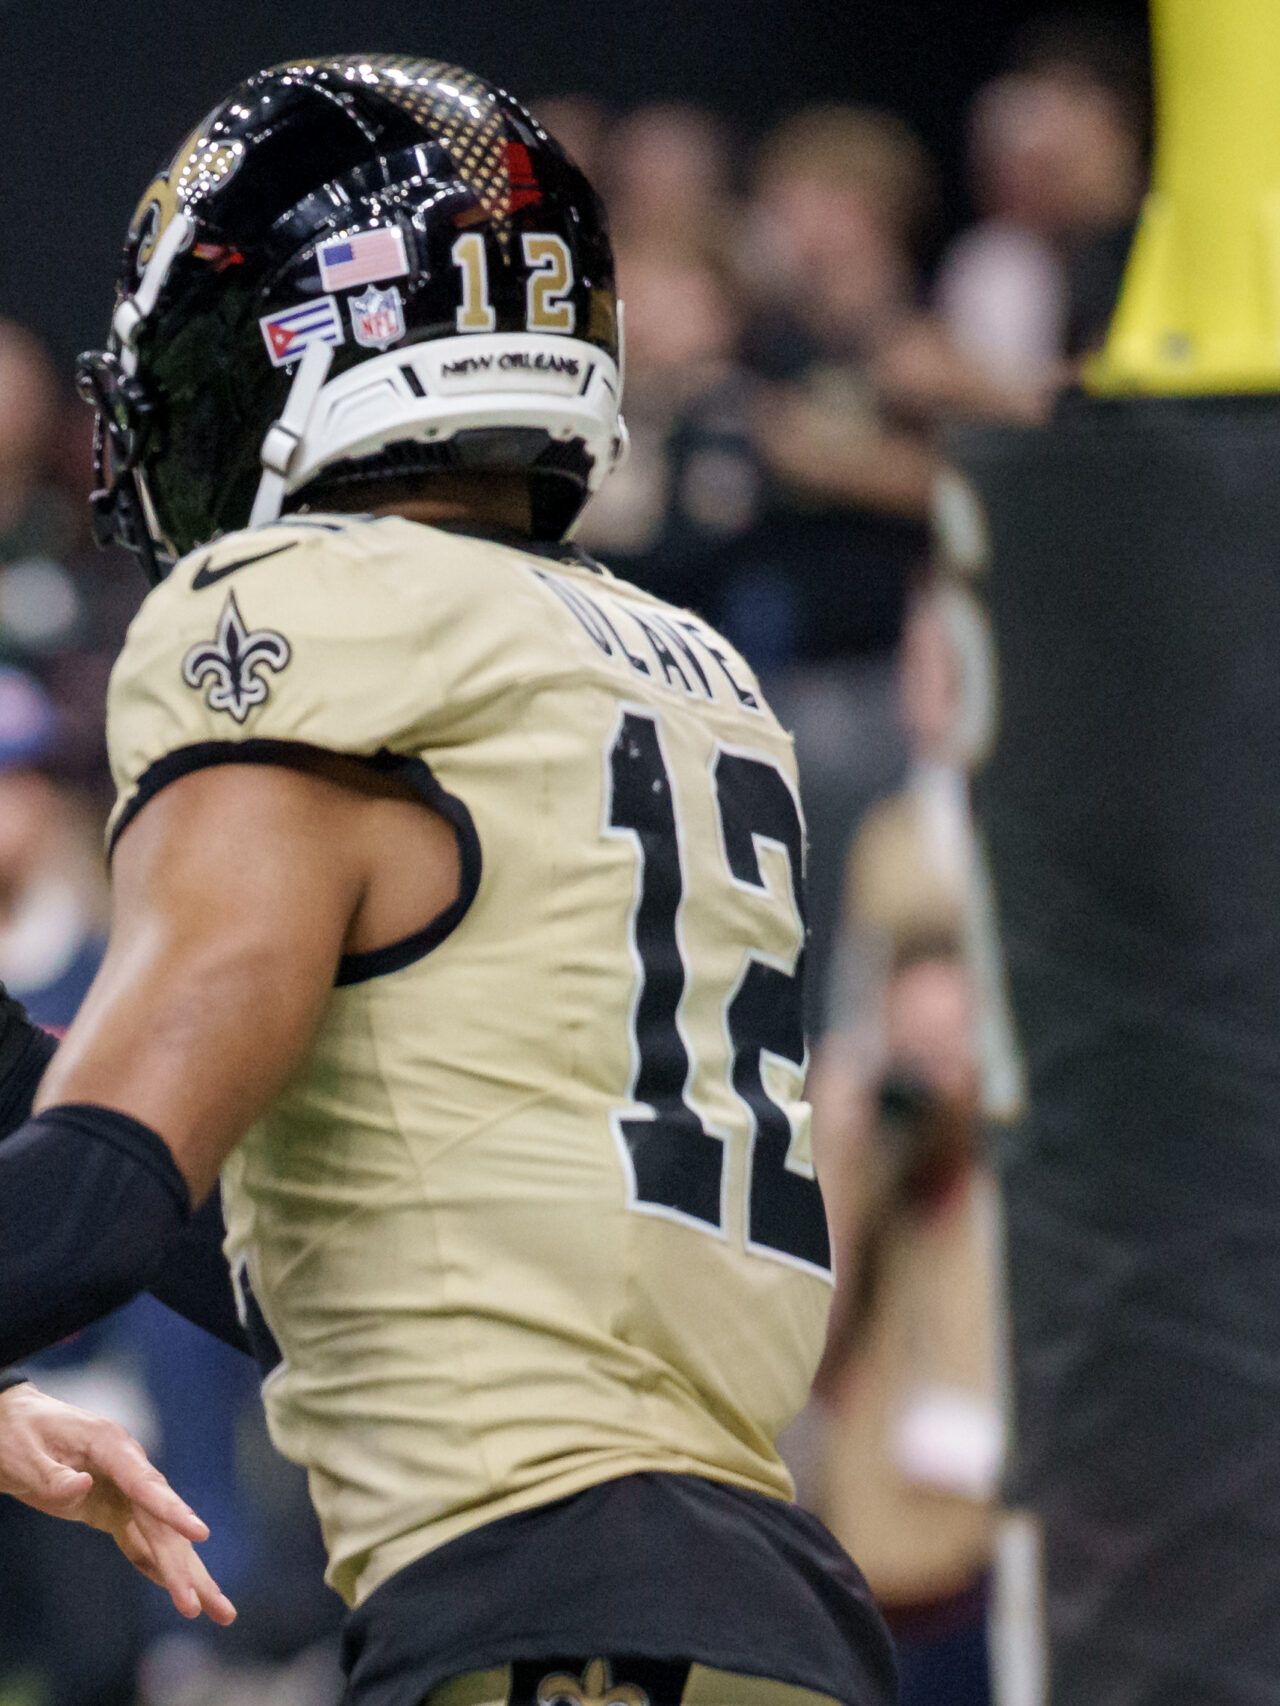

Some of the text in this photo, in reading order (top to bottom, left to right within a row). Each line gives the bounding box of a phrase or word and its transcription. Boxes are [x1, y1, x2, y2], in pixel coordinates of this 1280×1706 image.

[451, 232, 575, 334] 12
[441, 352, 579, 377] NEW ORLEANS
[601, 708, 836, 1285] 12
